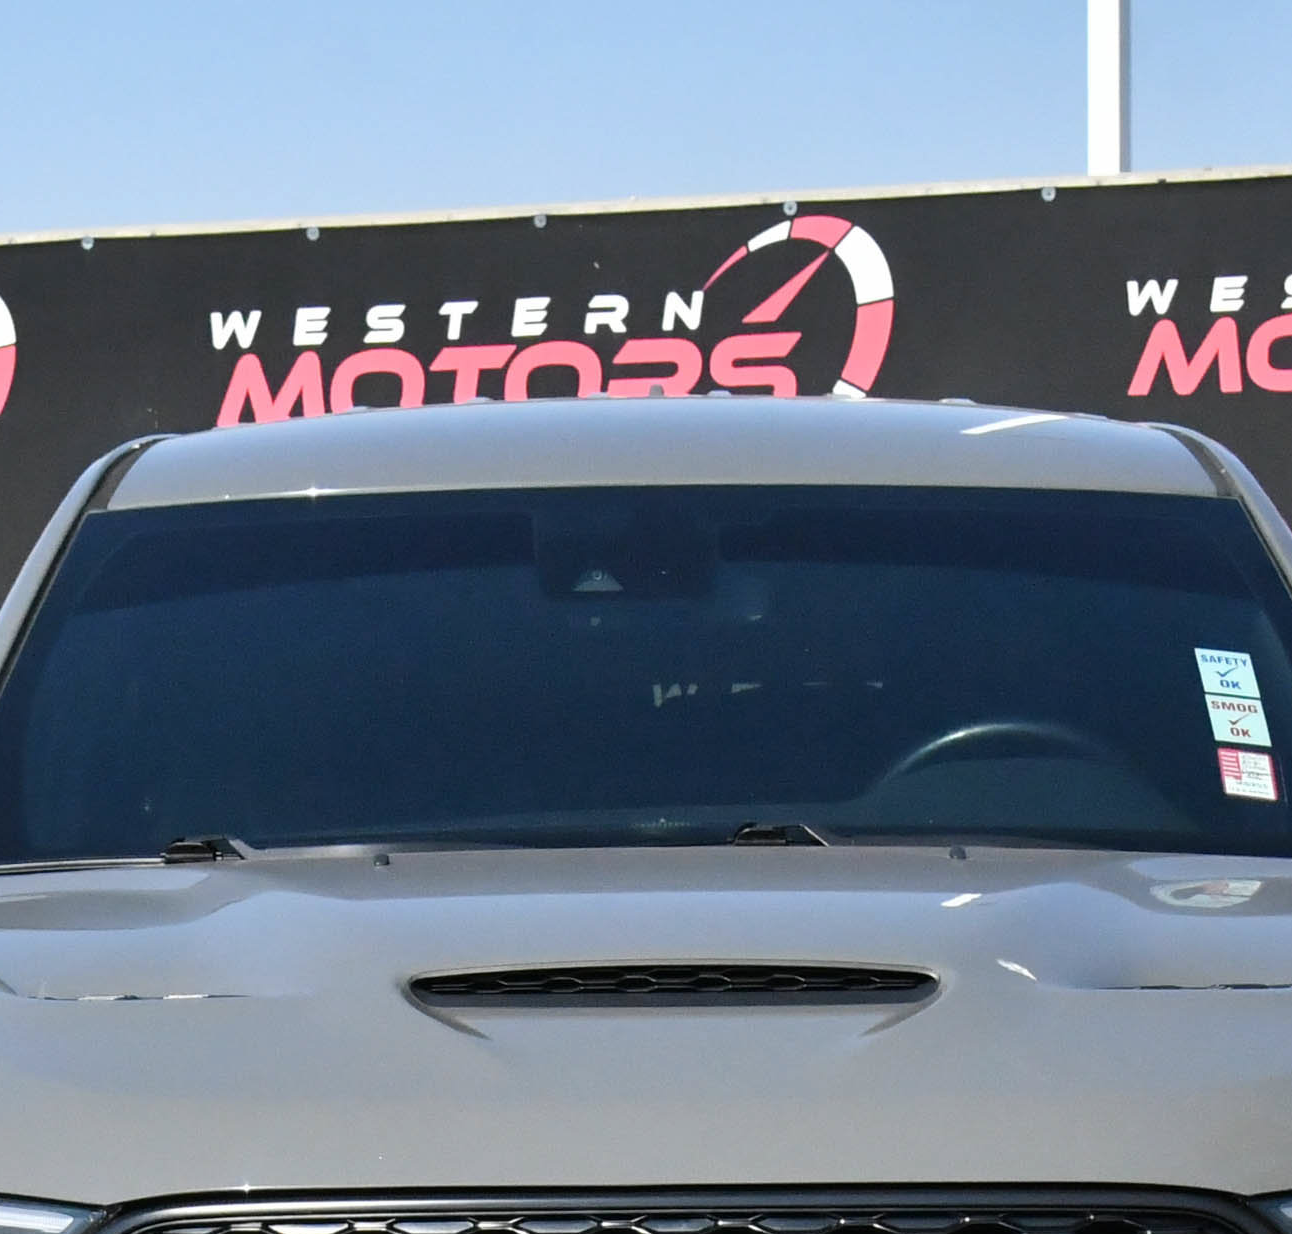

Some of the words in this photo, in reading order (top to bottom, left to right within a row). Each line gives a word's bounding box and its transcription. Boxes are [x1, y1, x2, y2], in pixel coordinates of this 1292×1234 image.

[209, 290, 705, 350] WESTERN
[215, 332, 802, 428] MOTORS
[1200, 653, 1247, 667] SAFETY
[1219, 679, 1241, 690] OK
[1210, 700, 1258, 714] SMOG
[1229, 727, 1251, 738] OK
